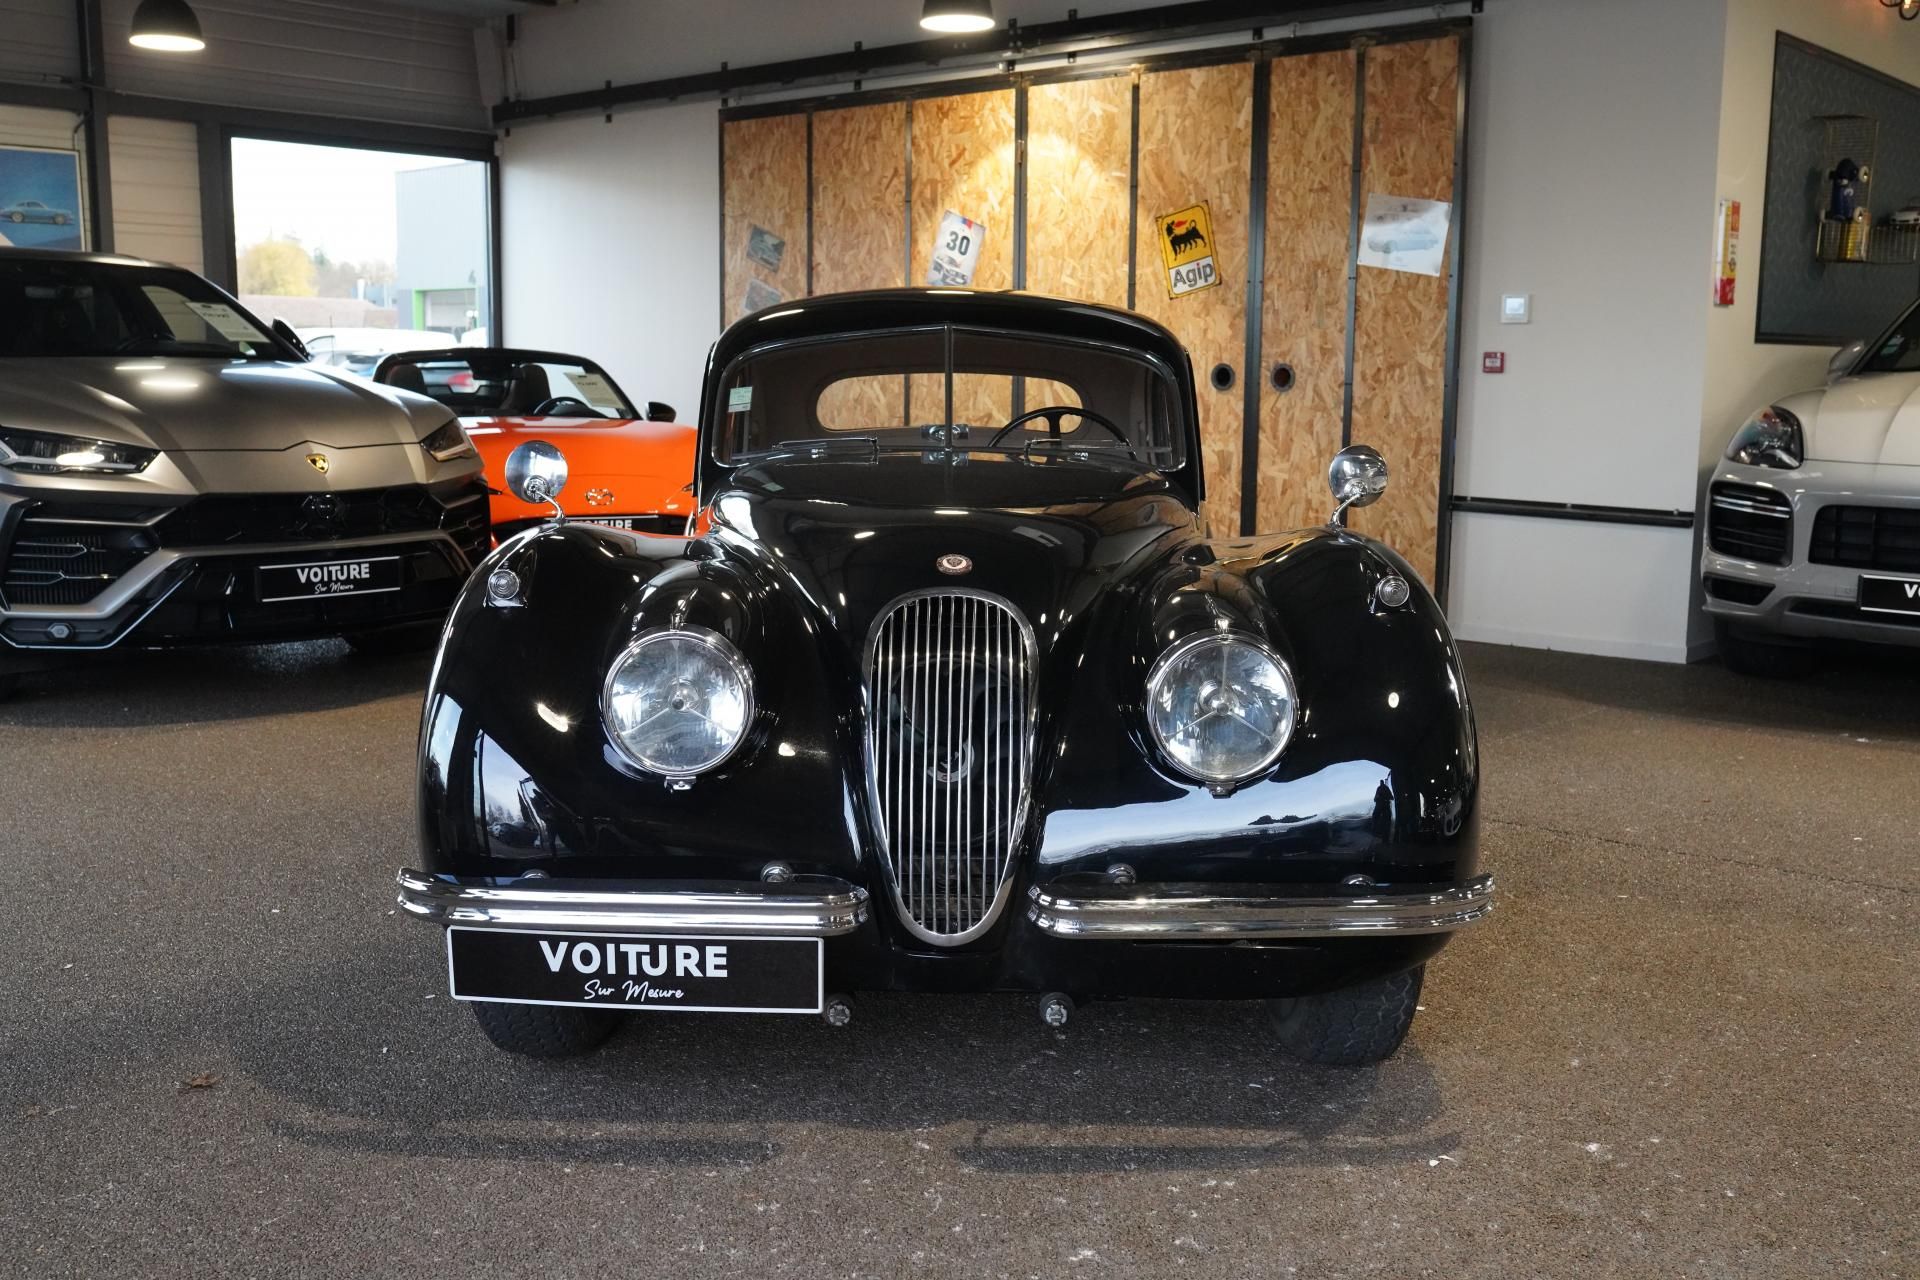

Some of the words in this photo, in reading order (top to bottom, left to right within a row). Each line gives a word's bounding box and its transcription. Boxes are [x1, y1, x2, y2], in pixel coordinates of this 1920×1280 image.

[946, 231, 970, 255] 30
[1174, 262, 1213, 288] Agip
[296, 563, 370, 583] VOITURE
[315, 583, 327, 594] Sur
[539, 940, 728, 978] VOITURE
[584, 979, 615, 1000] Sur
[622, 980, 684, 1002] Mesure
